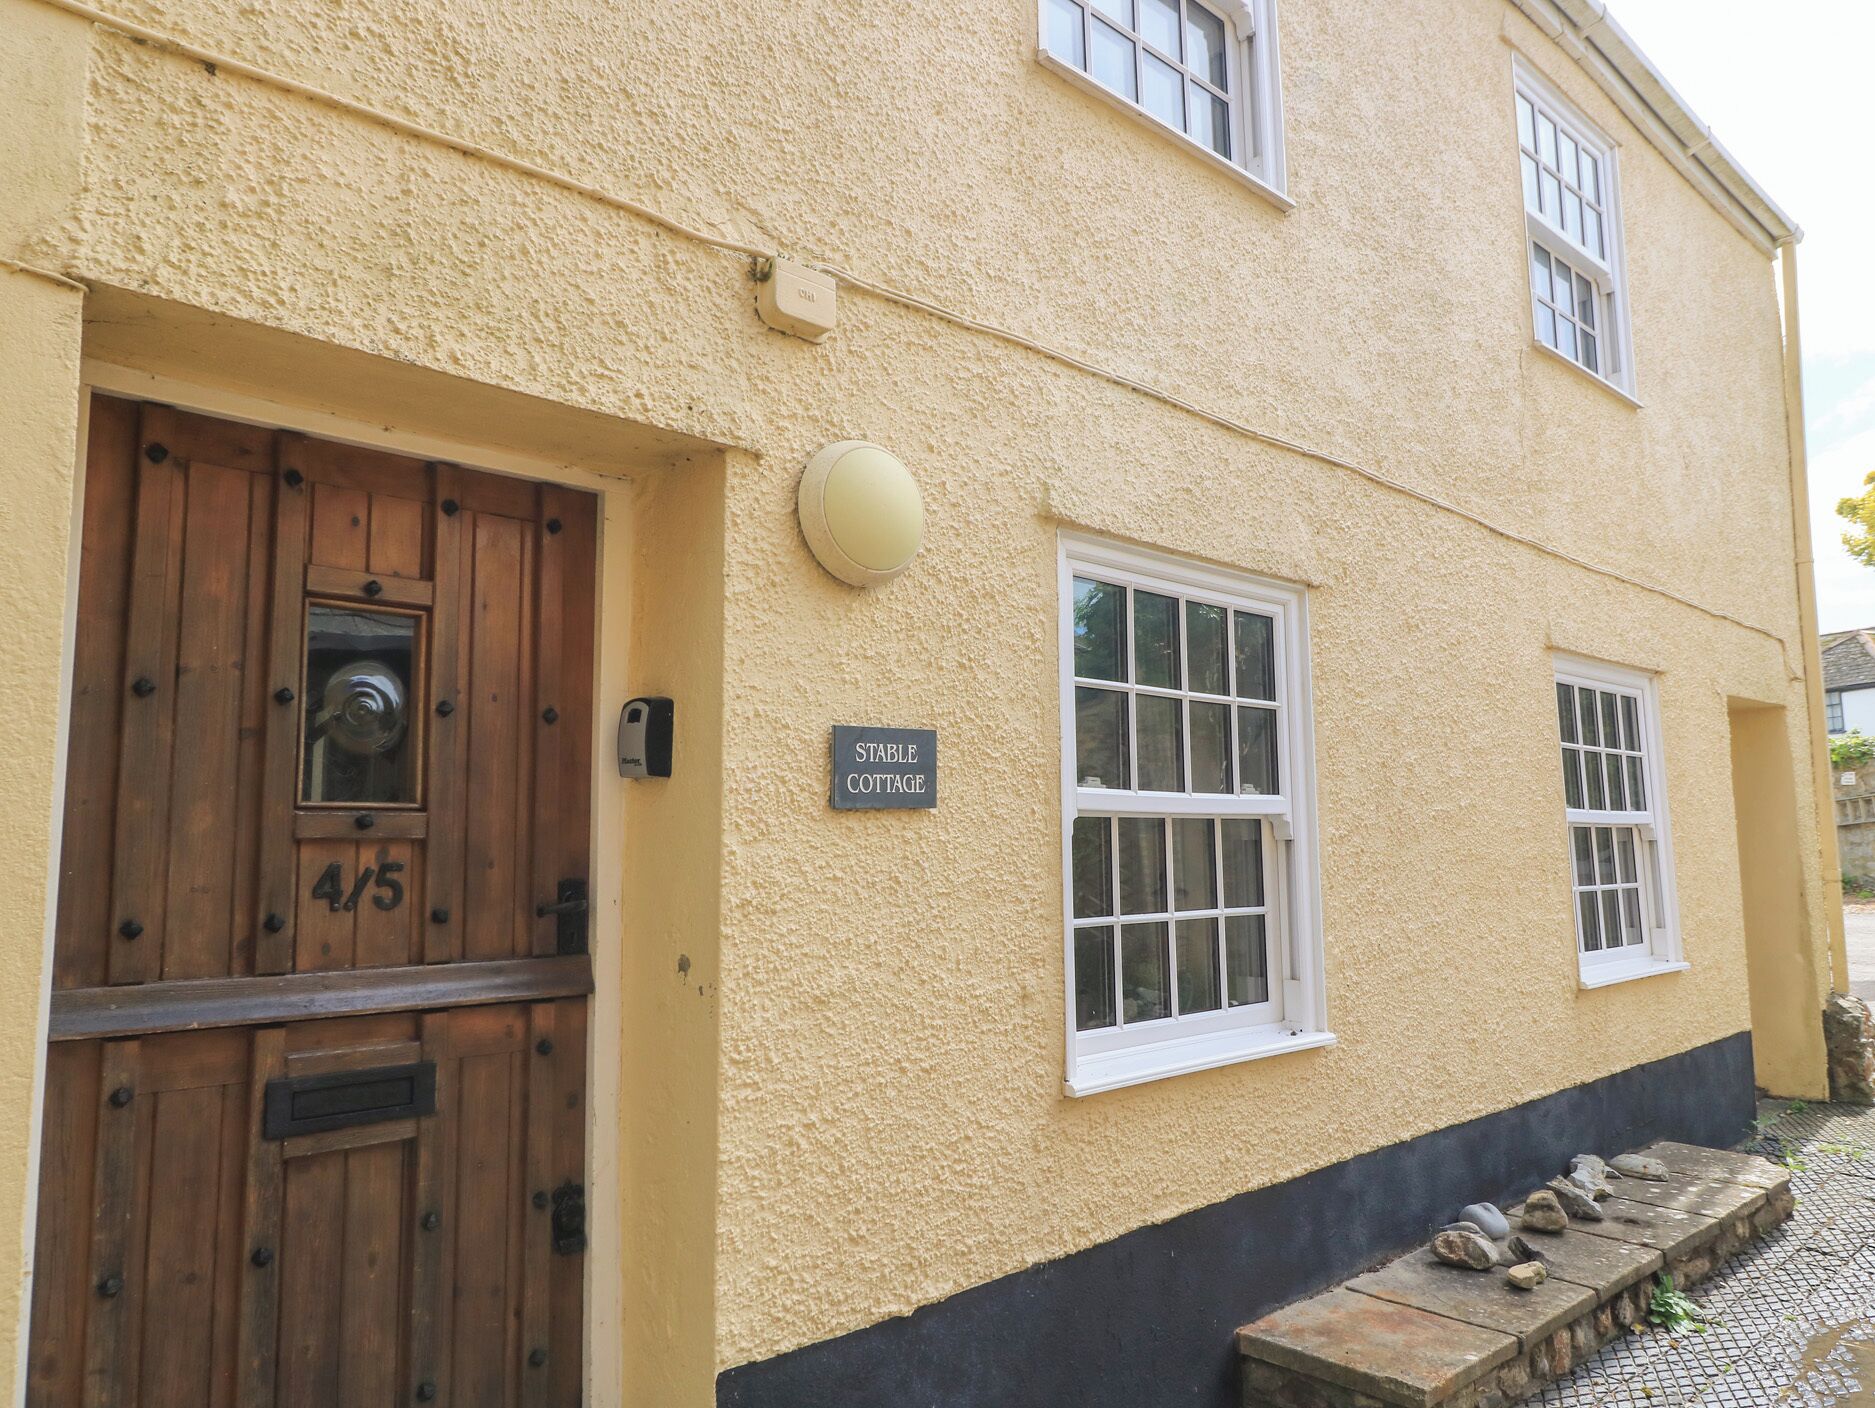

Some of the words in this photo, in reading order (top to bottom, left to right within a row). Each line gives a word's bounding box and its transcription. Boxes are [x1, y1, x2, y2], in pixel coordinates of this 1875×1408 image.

[855, 742, 919, 763] STABLE
[847, 773, 926, 794] COTTAGE
[312, 861, 405, 912] 4/5
